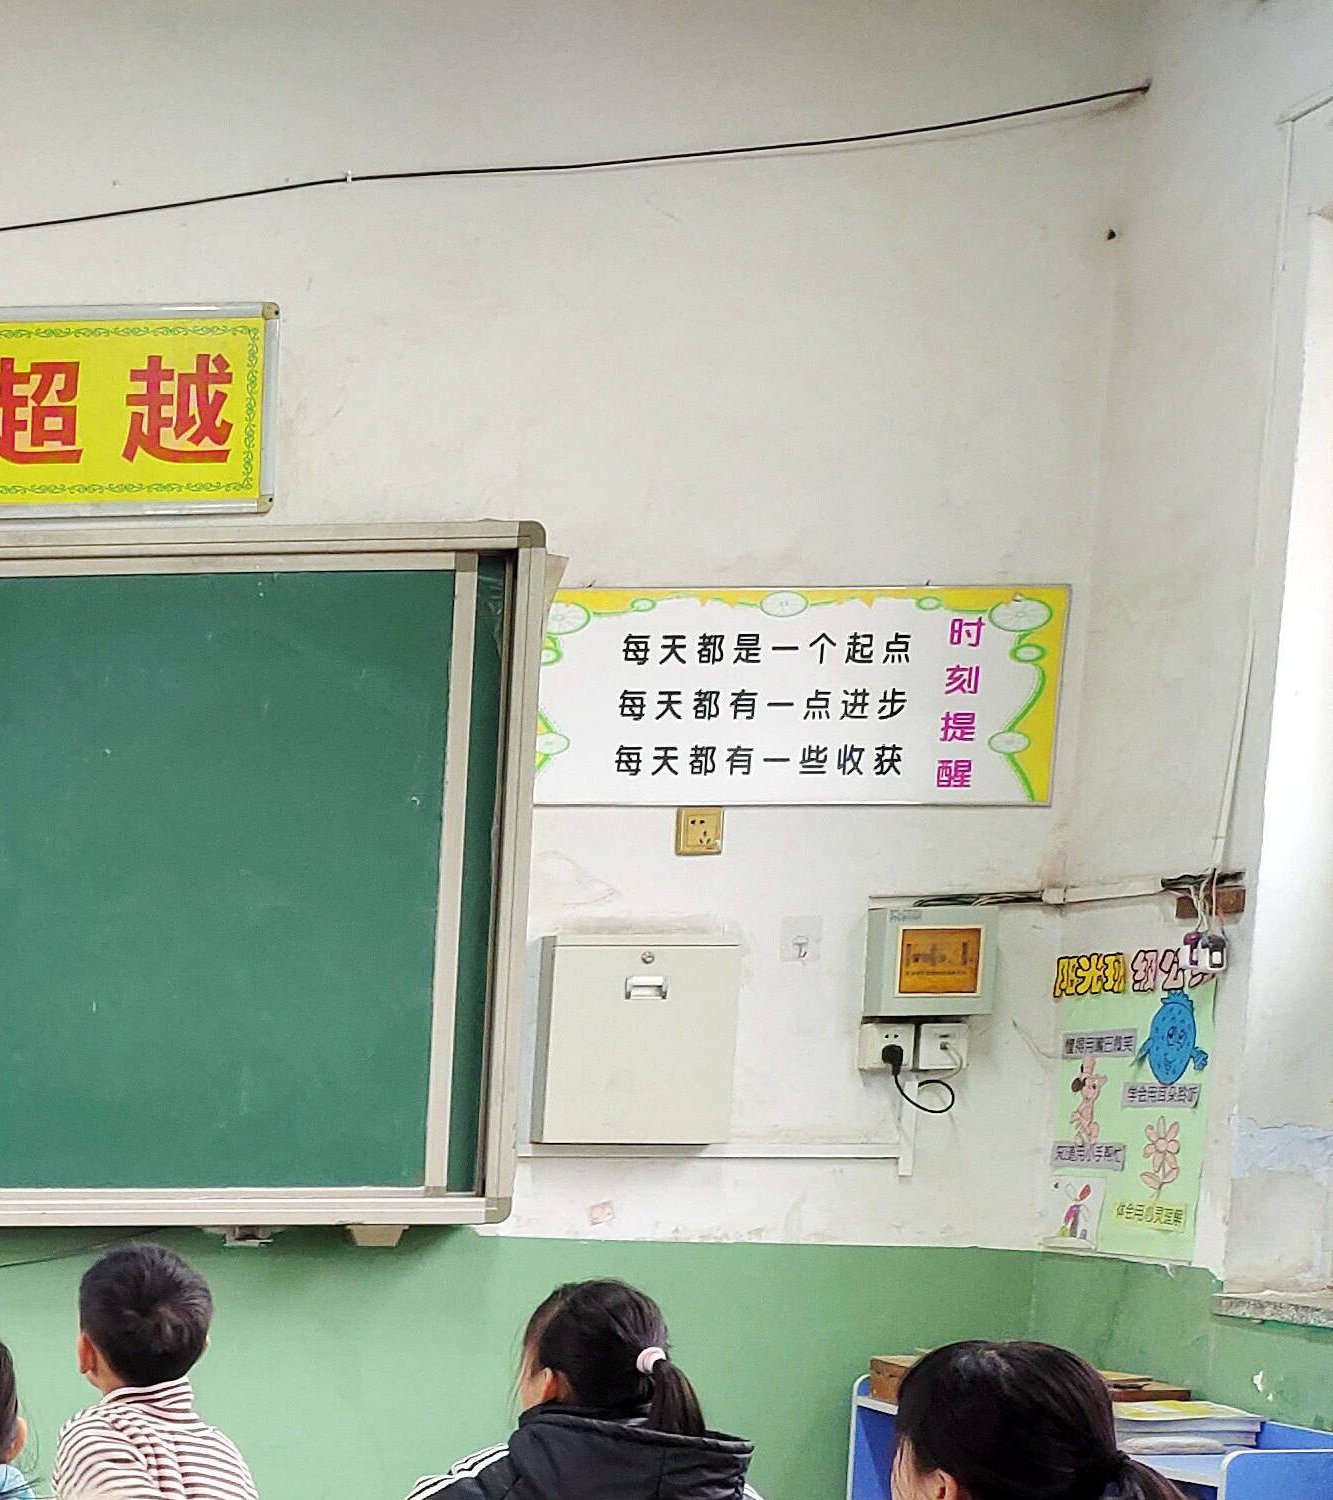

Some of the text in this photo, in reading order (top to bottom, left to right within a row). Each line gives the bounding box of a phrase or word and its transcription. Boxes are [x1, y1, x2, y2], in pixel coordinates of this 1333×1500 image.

[621, 632, 912, 666] 每天都是一个起点
[617, 688, 908, 722] 每天都有一点进步
[935, 616, 986, 788] 时刻提醒
[613, 743, 904, 777] 每天都有一些收获
